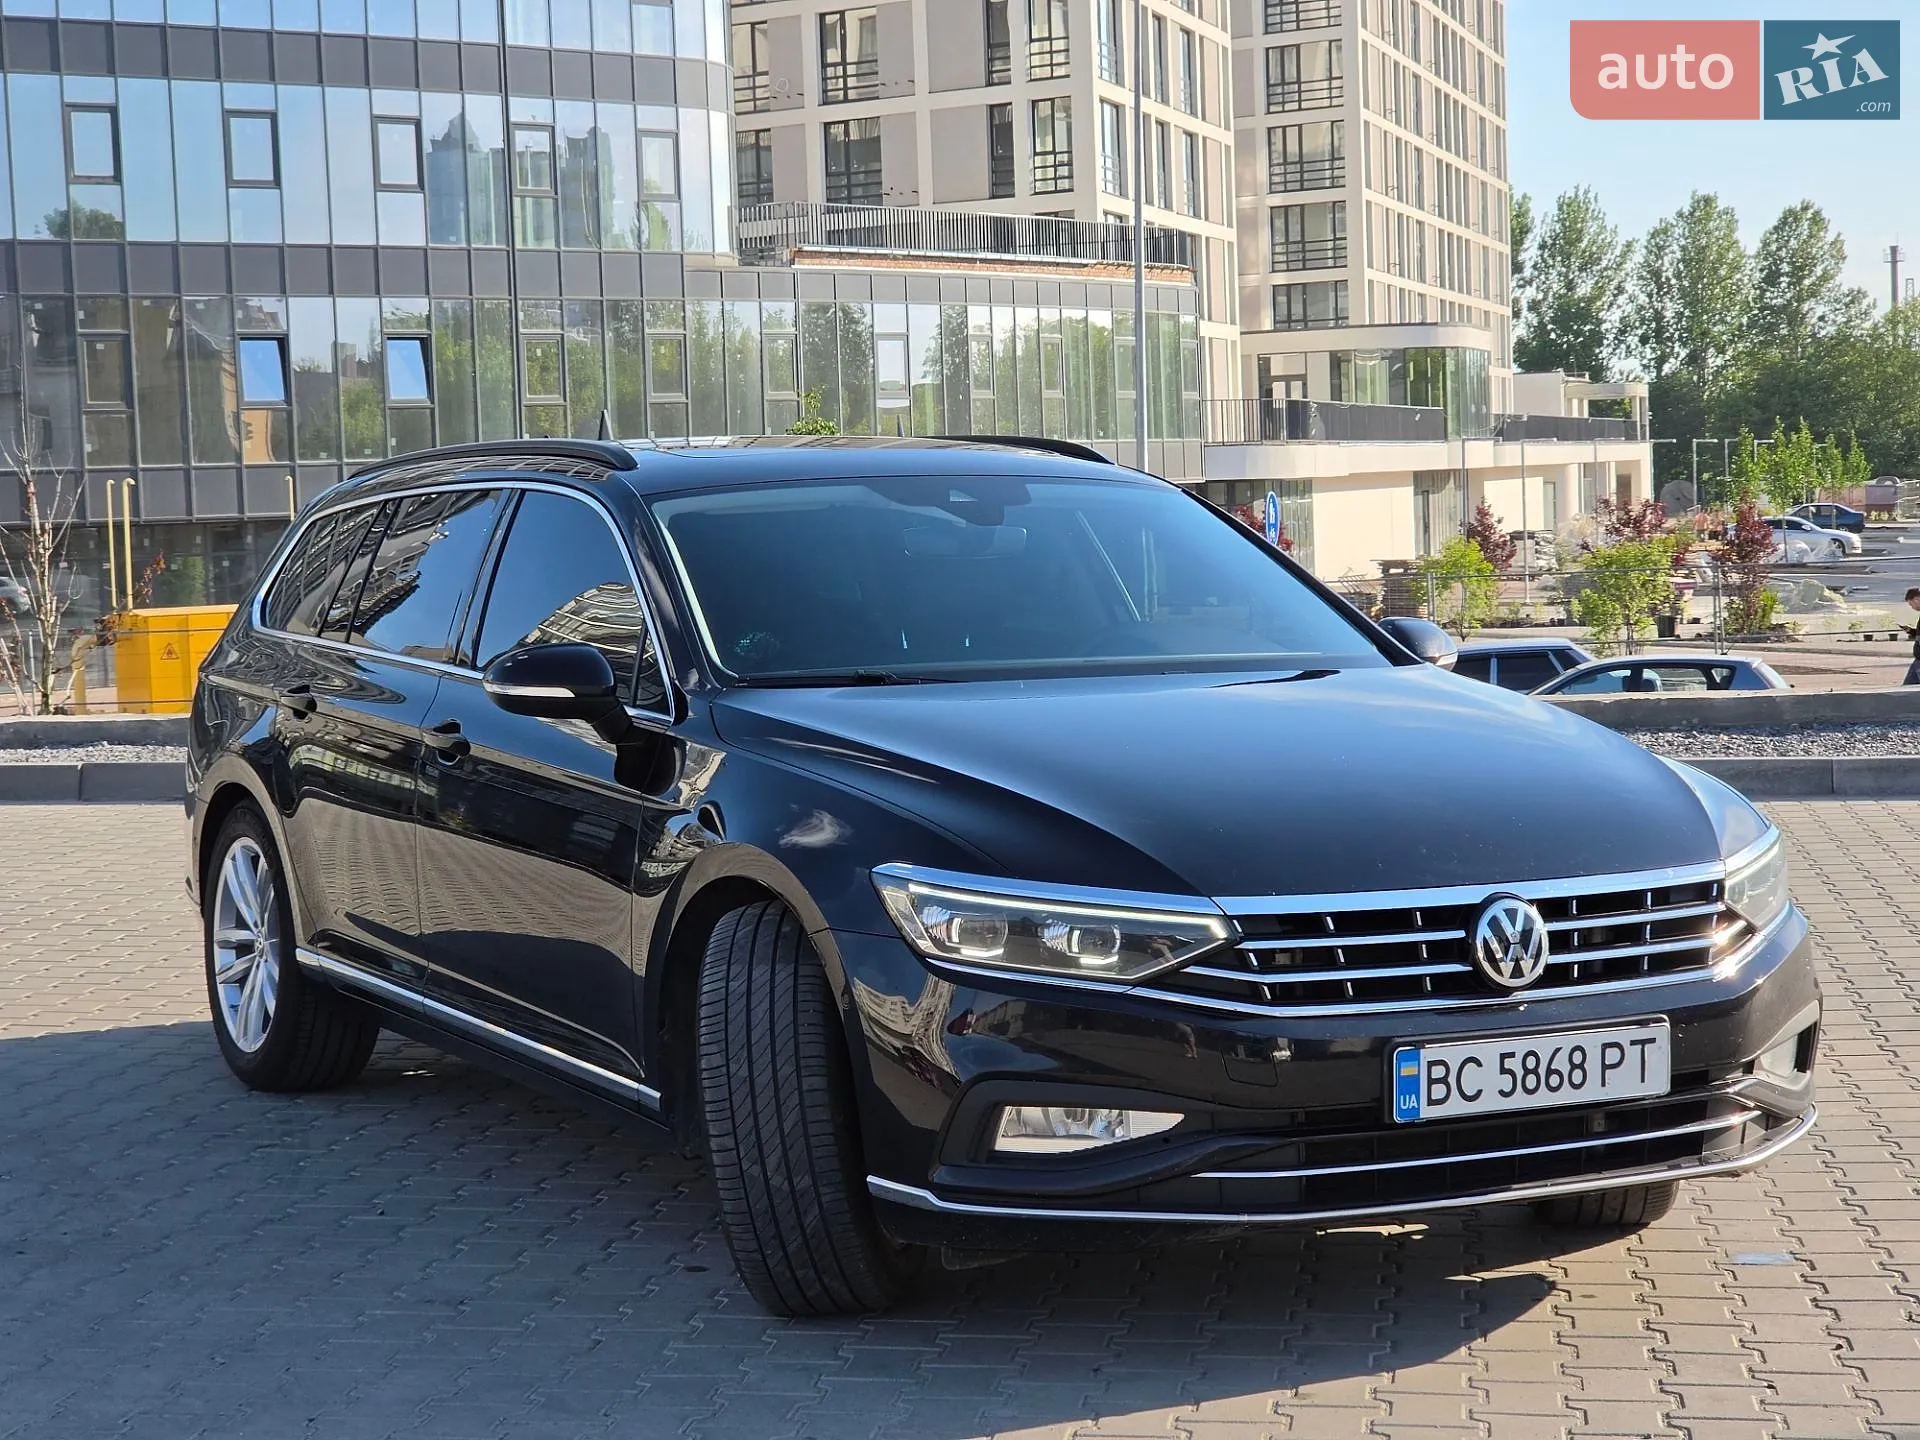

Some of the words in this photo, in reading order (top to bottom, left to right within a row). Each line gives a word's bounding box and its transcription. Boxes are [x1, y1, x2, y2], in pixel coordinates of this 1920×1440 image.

[1477, 900, 1547, 986] VW
[1400, 1094, 1418, 1110] UA
[1426, 1055, 1484, 1107] BC
[1497, 1044, 1588, 1099] 5868
[1600, 1037, 1657, 1088] PT
